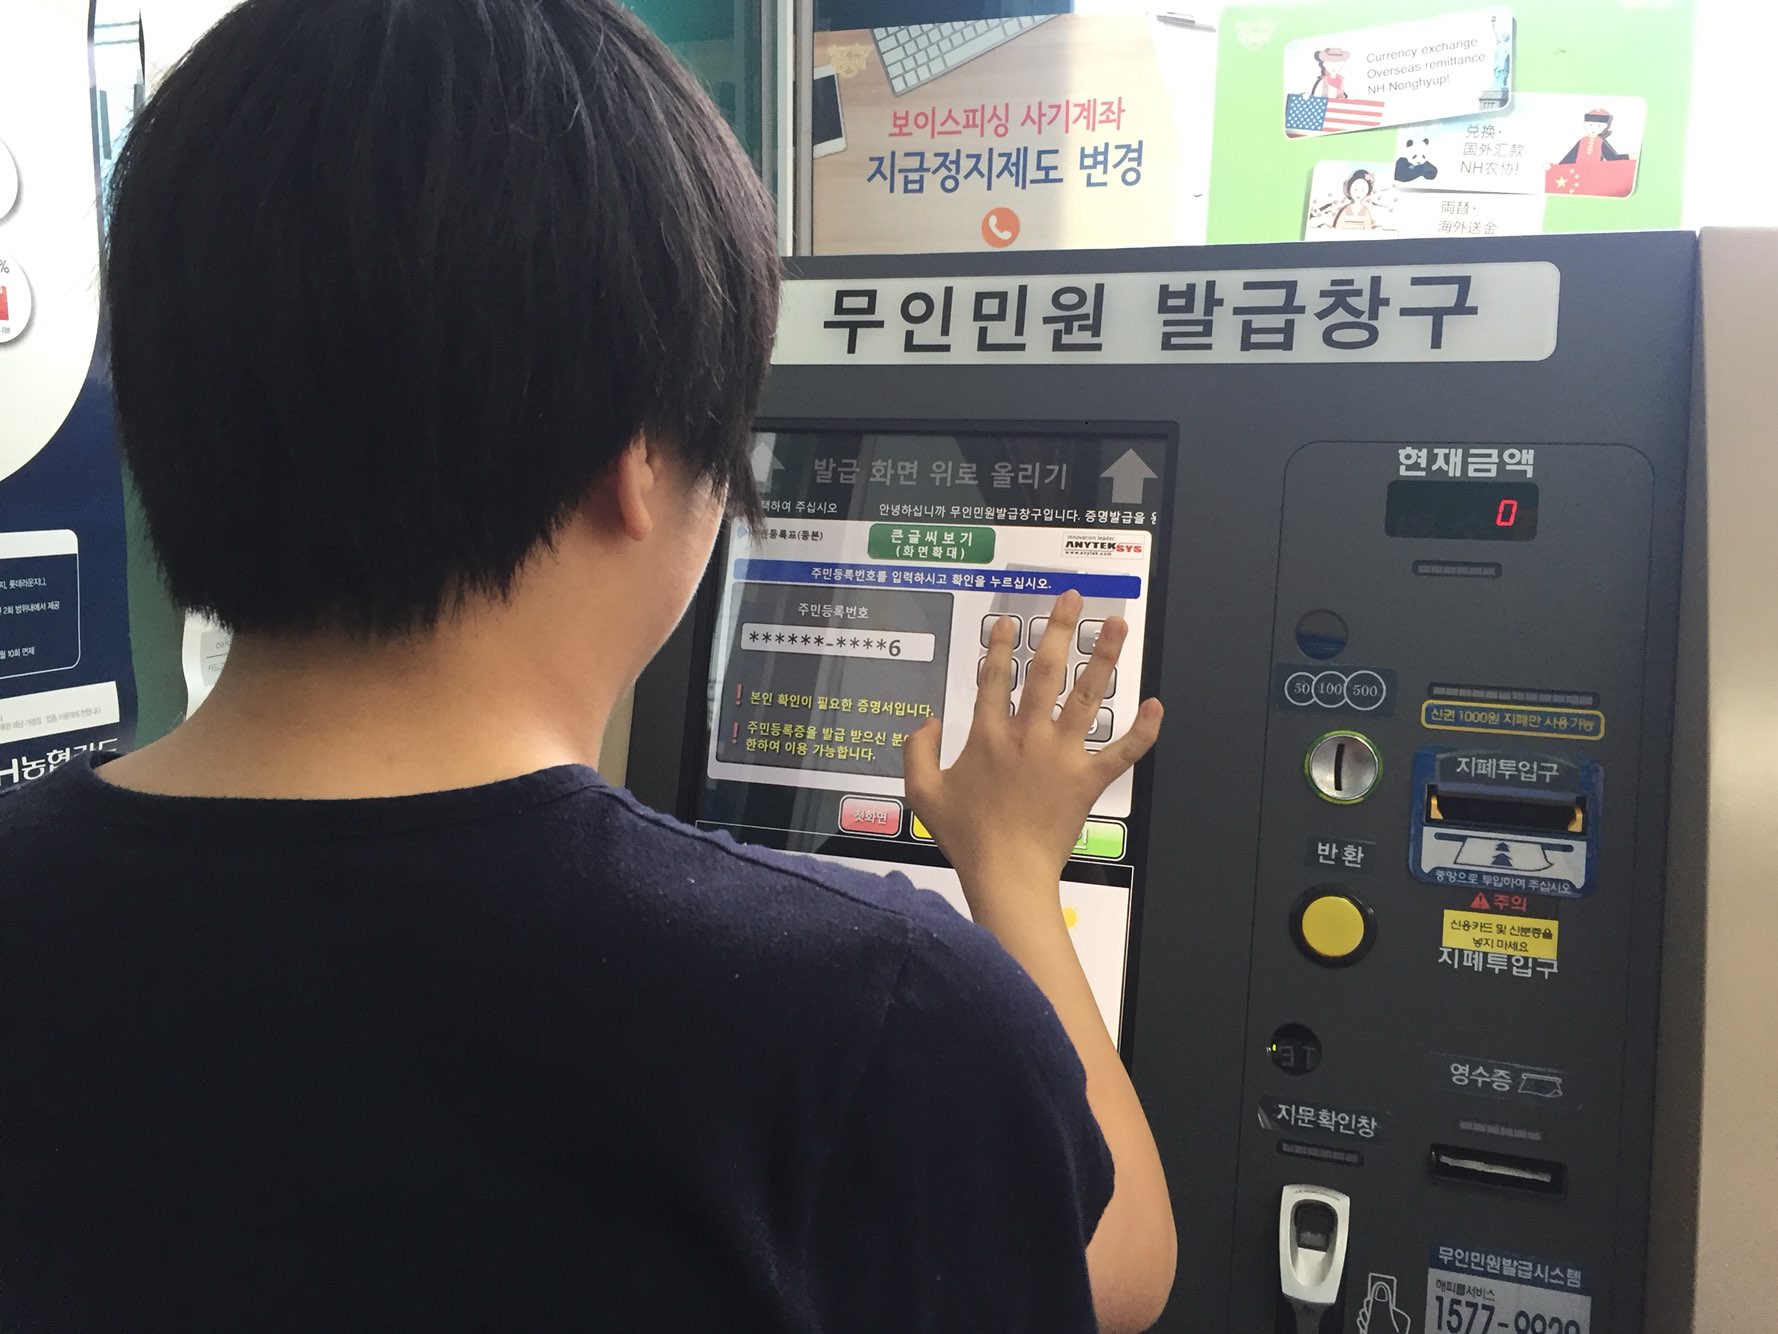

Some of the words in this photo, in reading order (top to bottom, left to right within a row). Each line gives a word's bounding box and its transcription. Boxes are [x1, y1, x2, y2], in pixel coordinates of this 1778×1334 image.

[1366, 47, 1417, 64] Currency
[1421, 37, 1478, 56] exchange
[1367, 64, 1421, 79] Overseas
[1425, 53, 1486, 70] remittance
[1368, 83, 1385, 95] NH
[1389, 74, 1450, 92] Nonghyup!
[887, 103, 1010, 140] 보이스피싱
[1020, 97, 1126, 135] 사기계좌
[1463, 142, 1524, 157] 国外汇款
[866, 146, 1064, 195] 지급정지제도
[1079, 140, 1144, 188] 변경
[1438, 220, 1497, 235] 海外送金
[823, 282, 1105, 354] 무인민원
[1155, 275, 1479, 352] 발급창구
[813, 457, 861, 485] 발급
[868, 458, 919, 487] 화면
[929, 460, 980, 488] 위로
[990, 461, 1068, 491] 올리기
[1398, 447, 1536, 478] 현재금액
[795, 501, 838, 514] 주십시오
[879, 503, 946, 519] 안녕하십니까
[949, 505, 1081, 522] 무인민원발급창구입니다.
[1084, 510, 1146, 525] 증명발급을
[1496, 499, 1519, 527] 0
[811, 567, 888, 583] 주민등록번호를
[892, 571, 948, 586] 입력하시고
[952, 573, 986, 588] 확인을
[989, 576, 1052, 591] 누르십시오.
[798, 603, 870, 620] 주민등록번호
[1294, 682, 1311, 695] 50
[1318, 682, 1342, 696] 100
[1352, 684, 1379, 698] 500
[750, 691, 774, 706] 본인
[777, 693, 813, 709] 확인이
[817, 696, 853, 712] 필요한
[857, 699, 935, 718] 증명서입니다.
[1431, 708, 1456, 722] 신권
[1458, 710, 1500, 726] 1000원
[1503, 713, 1542, 729] 지폐만
[747, 721, 818, 741] 주민등록증을
[822, 727, 847, 742] 발급
[850, 730, 887, 747] 받으신
[891, 732, 910, 748] 분
[745, 738, 780, 753] 한하여
[784, 741, 809, 757] 이용
[812, 743, 877, 762] 가능합니다.
[1456, 756, 1560, 783] 지폐투입구
[1435, 869, 1479, 885] 중앙으로
[1482, 874, 1526, 890] 투입하여
[1528, 880, 1574, 895] 주십시오
[1493, 893, 1528, 913] 주의
[1450, 918, 1494, 935] 신용카드
[1496, 923, 1508, 936] 및
[1509, 925, 1553, 941] 신분증을
[1496, 937, 1529, 953] 마세요
[1438, 946, 1559, 980] 지폐투입구
[1450, 1061, 1513, 1093] 영수증
[1276, 1103, 1378, 1138] 지문확인창
[1438, 1246, 1582, 1289] 무인민원발급시스템
